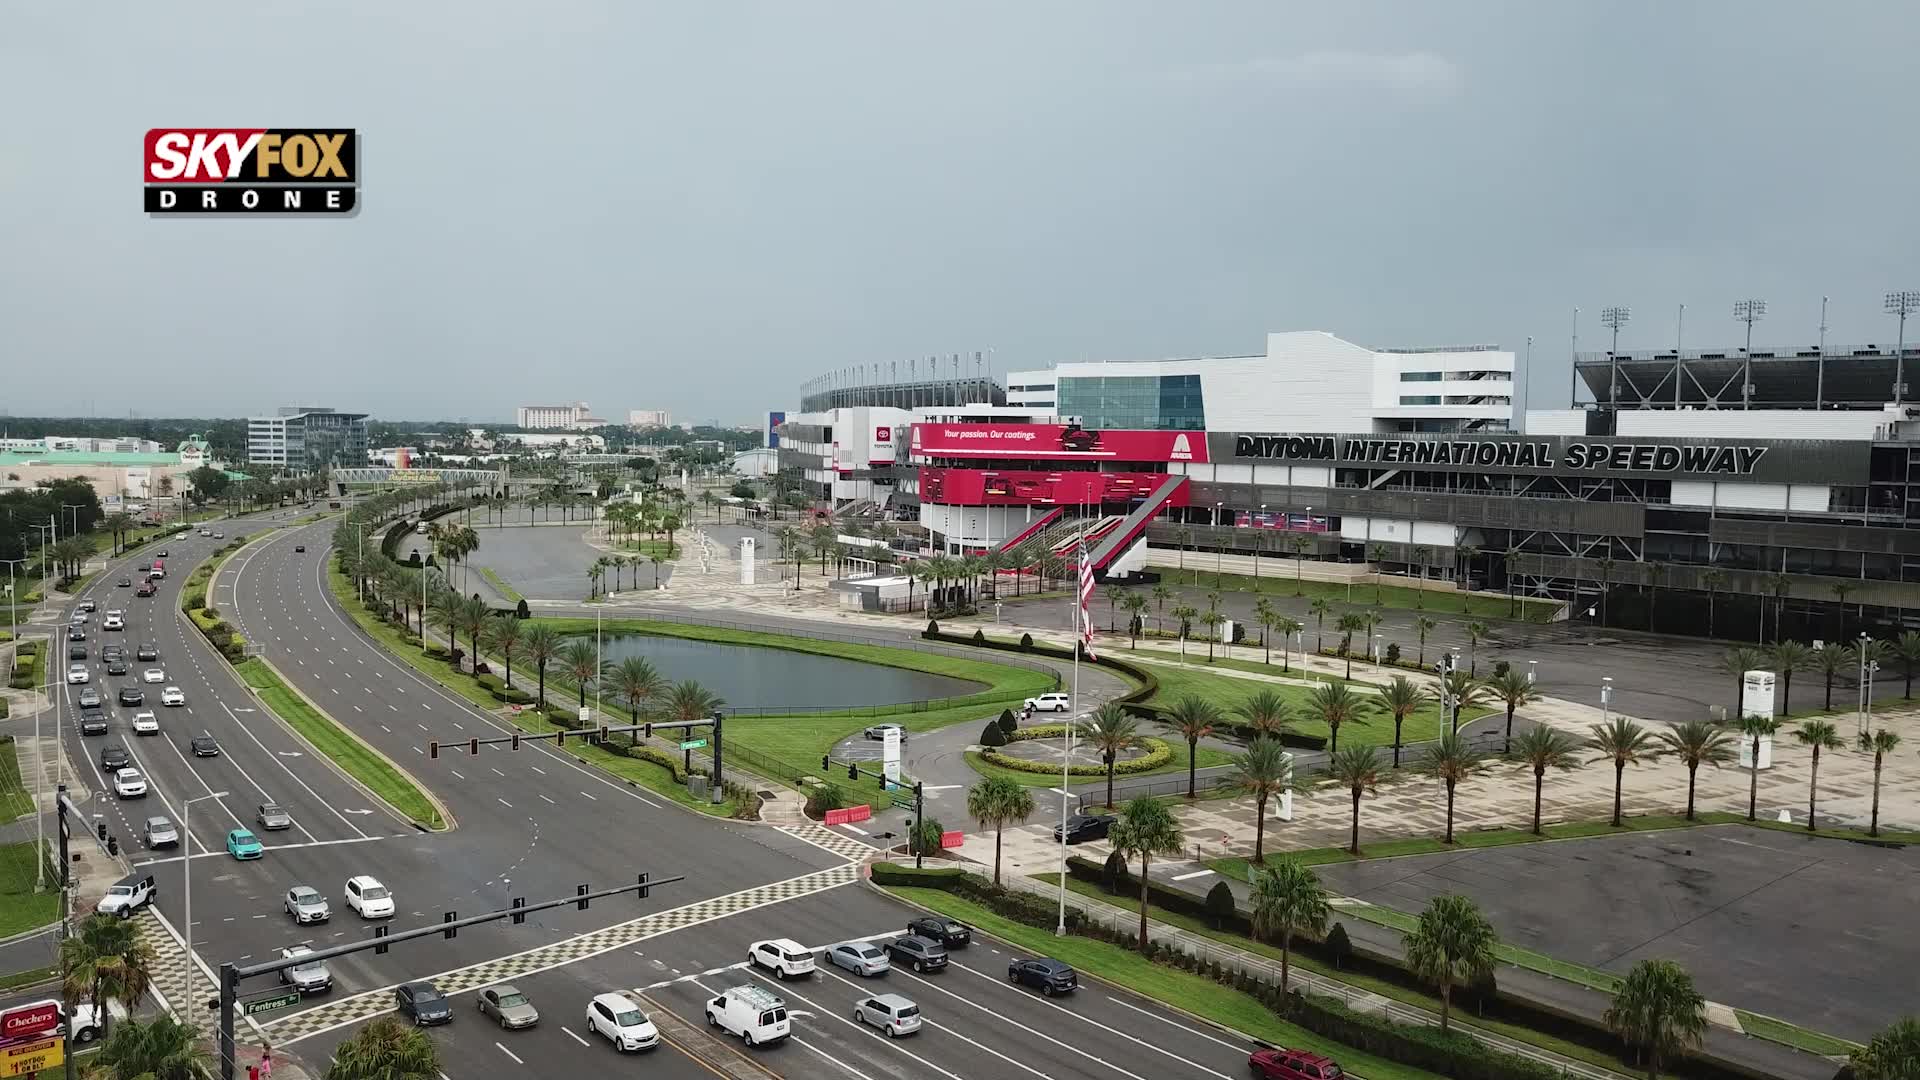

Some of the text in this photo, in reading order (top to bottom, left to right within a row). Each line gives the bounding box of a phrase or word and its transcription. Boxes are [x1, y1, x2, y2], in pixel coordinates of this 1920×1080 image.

[944, 429, 1036, 441] Your passion. Our coatings.
[1235, 435, 1768, 474] DAYTONA INTERNATIONAL SPEEDWAY
[249, 999, 287, 1013] Fentress
[7, 1014, 52, 1028] Checkers
